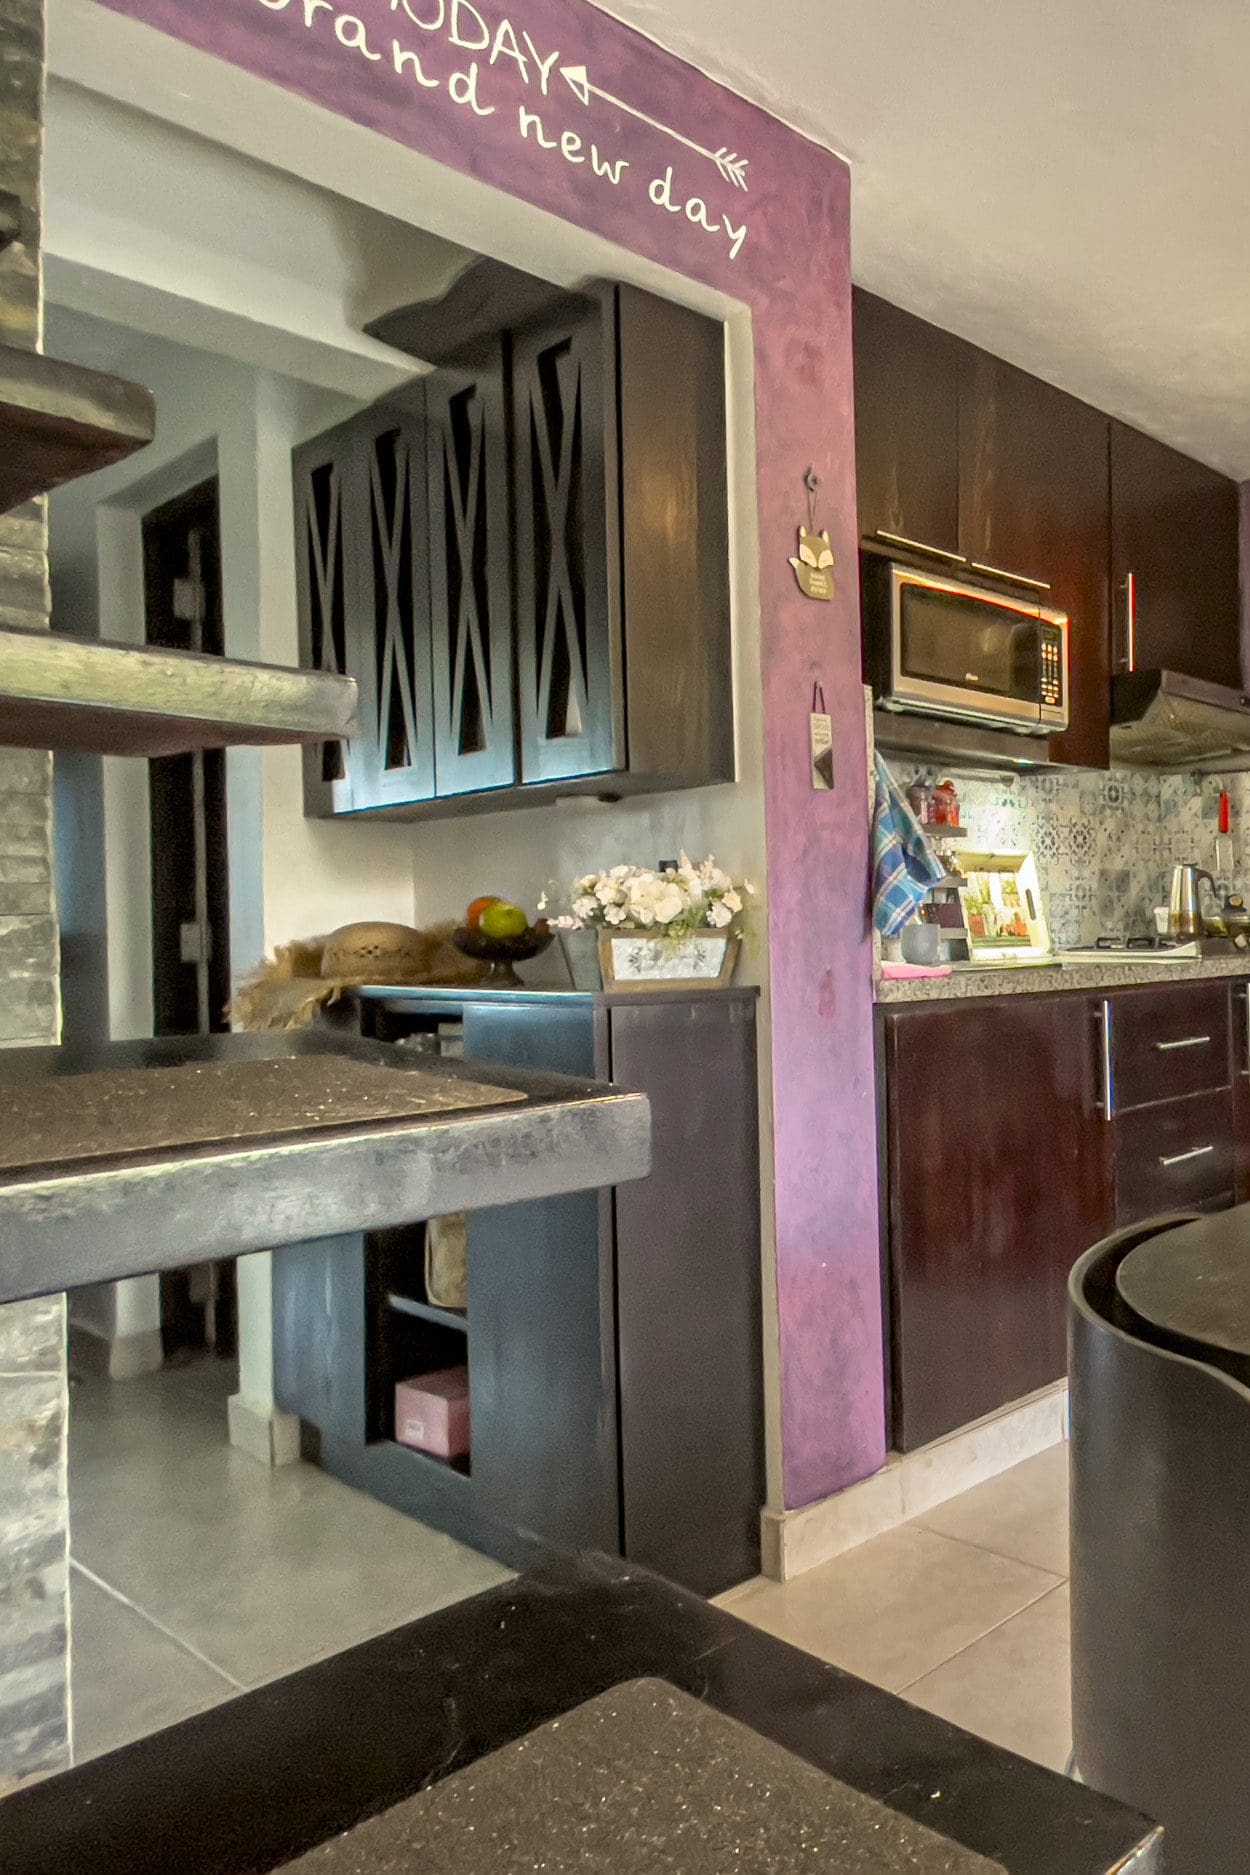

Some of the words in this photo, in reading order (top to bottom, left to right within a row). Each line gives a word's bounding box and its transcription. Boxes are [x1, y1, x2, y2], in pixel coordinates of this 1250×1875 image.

[257, 0, 495, 116] rand
[518, 105, 630, 185] new
[648, 166, 747, 260] day
[390, 0, 560, 95] ODAY
